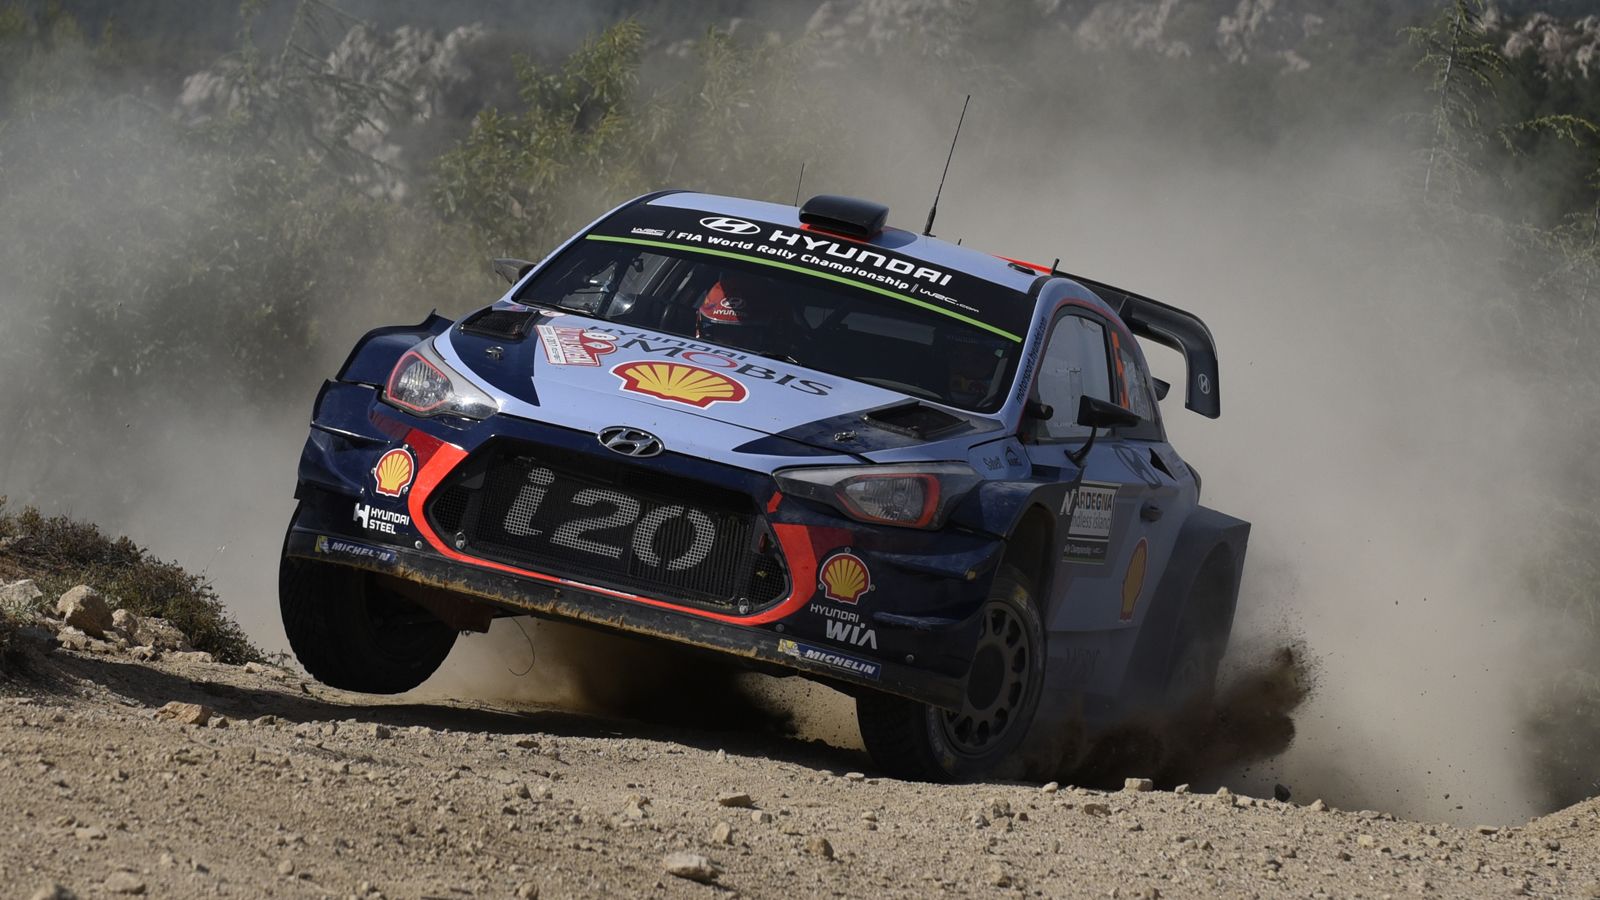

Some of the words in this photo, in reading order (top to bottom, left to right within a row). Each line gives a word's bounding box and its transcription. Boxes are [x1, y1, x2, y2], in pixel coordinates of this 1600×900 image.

[676, 232, 703, 242] FIA
[707, 236, 754, 250] World
[756, 245, 798, 260] Rally
[800, 253, 910, 290] Championship
[768, 229, 953, 287] HYUNDAI
[588, 326, 748, 361] HYUNDAI
[618, 338, 833, 397] MOBIS
[370, 507, 410, 526] HYUNDAI
[1076, 491, 1113, 511] ARDEGNA
[369, 520, 397, 535] STEEL
[504, 467, 716, 571] i20
[810, 603, 860, 623] HYUNDAI
[826, 619, 878, 650] WIA
[804, 649, 876, 675] MICHELIN
